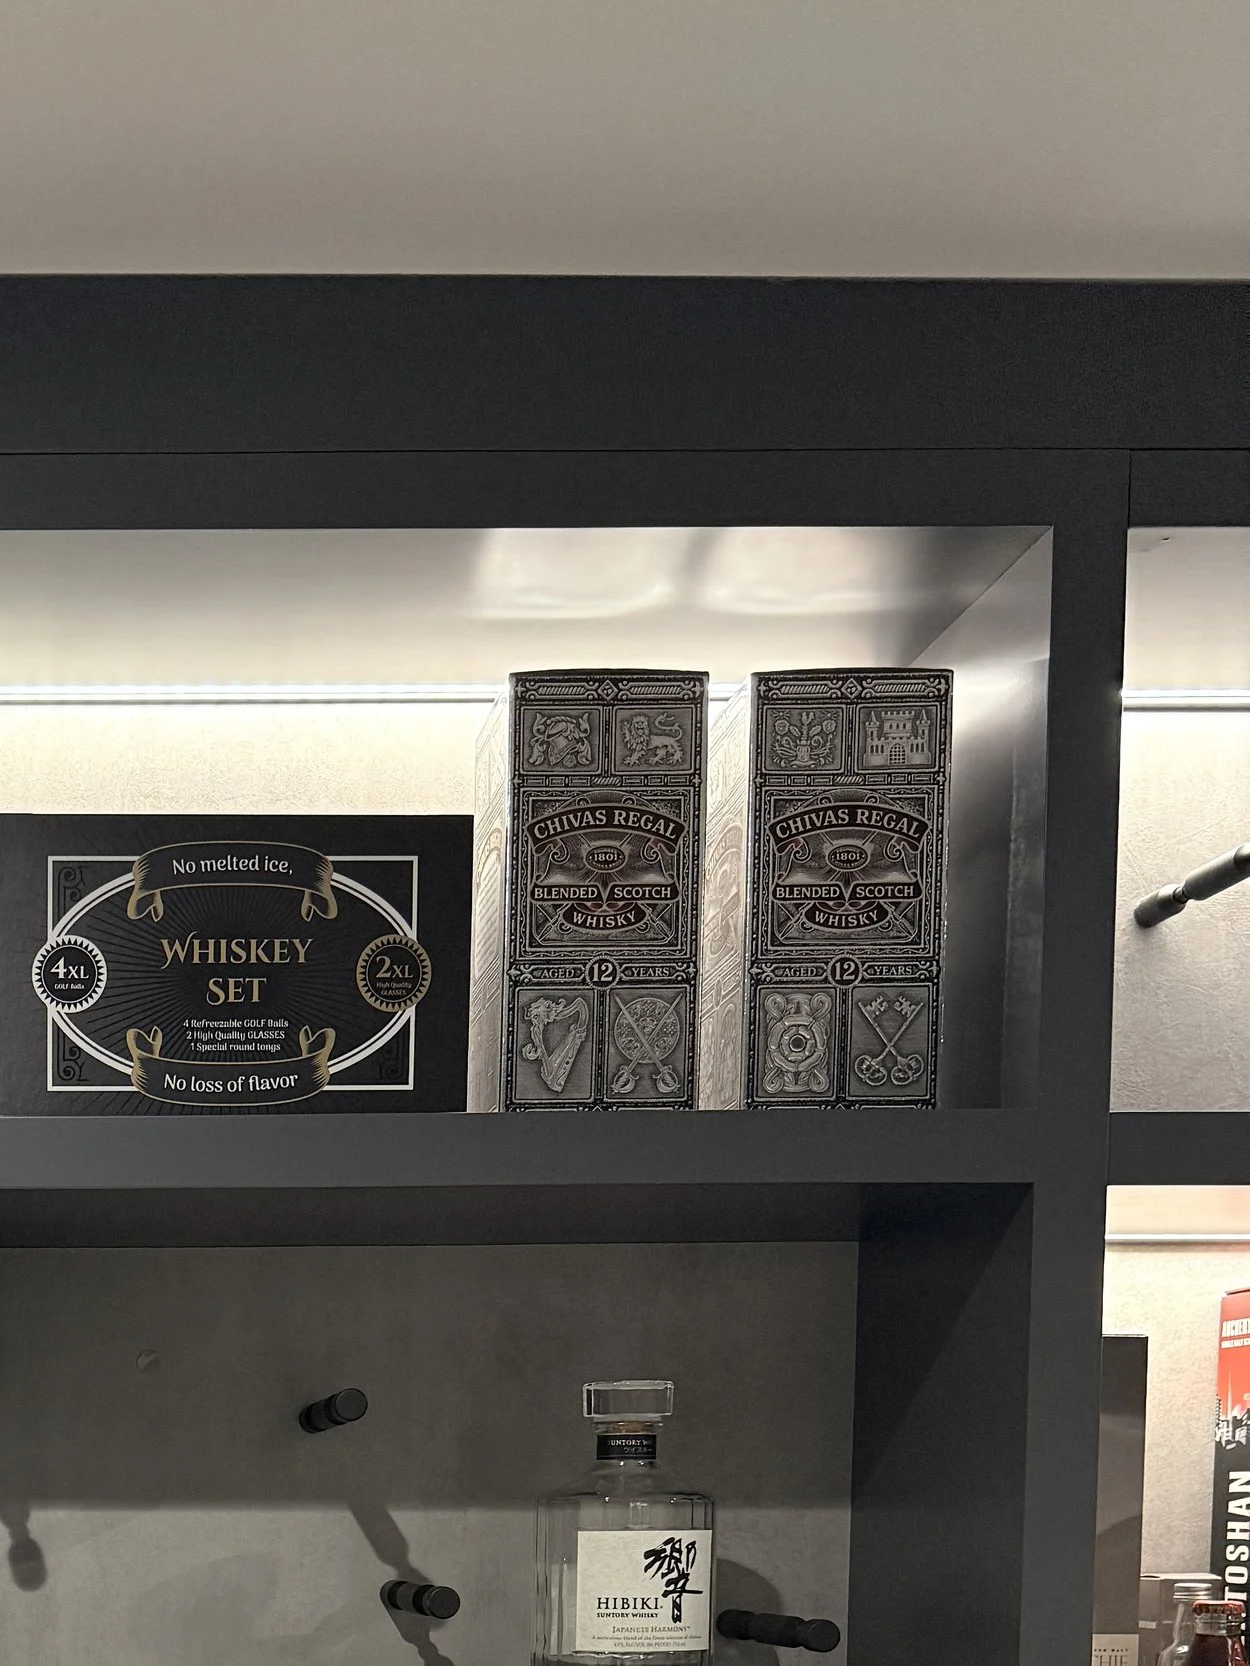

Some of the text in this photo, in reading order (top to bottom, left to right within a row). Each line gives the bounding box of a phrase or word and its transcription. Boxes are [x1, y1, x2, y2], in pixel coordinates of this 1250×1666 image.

[533, 809, 678, 840] CHIVAS REGAL
[775, 808, 921, 839] CHIVAS REGAL
[172, 855, 294, 877] No melted ice,
[594, 852, 618, 861] 1801
[836, 852, 860, 861] 1801
[534, 885, 672, 899] BLENDED SCOTCH
[775, 884, 914, 899] BLENDED SCOTCH
[573, 909, 637, 928] WHISKY
[814, 909, 879, 928] WHISKY
[160, 930, 313, 970] WHISKEY
[540, 963, 670, 983] AGED 12 YEARS
[782, 962, 913, 983] AGED 12 YEARS
[206, 977, 267, 1007] SET
[183, 1019, 189, 1027] 4
[243, 1019, 266, 1028] GOLF
[267, 1018, 289, 1028] Balls
[186, 1030, 286, 1041] 2 High Quality GLASSES
[196, 1042, 227, 1053] Special
[229, 1042, 255, 1051] round
[256, 1043, 281, 1053] tongs
[163, 1073, 299, 1094] No loss of flavor
[596, 1597, 659, 1610] HIBIKI
